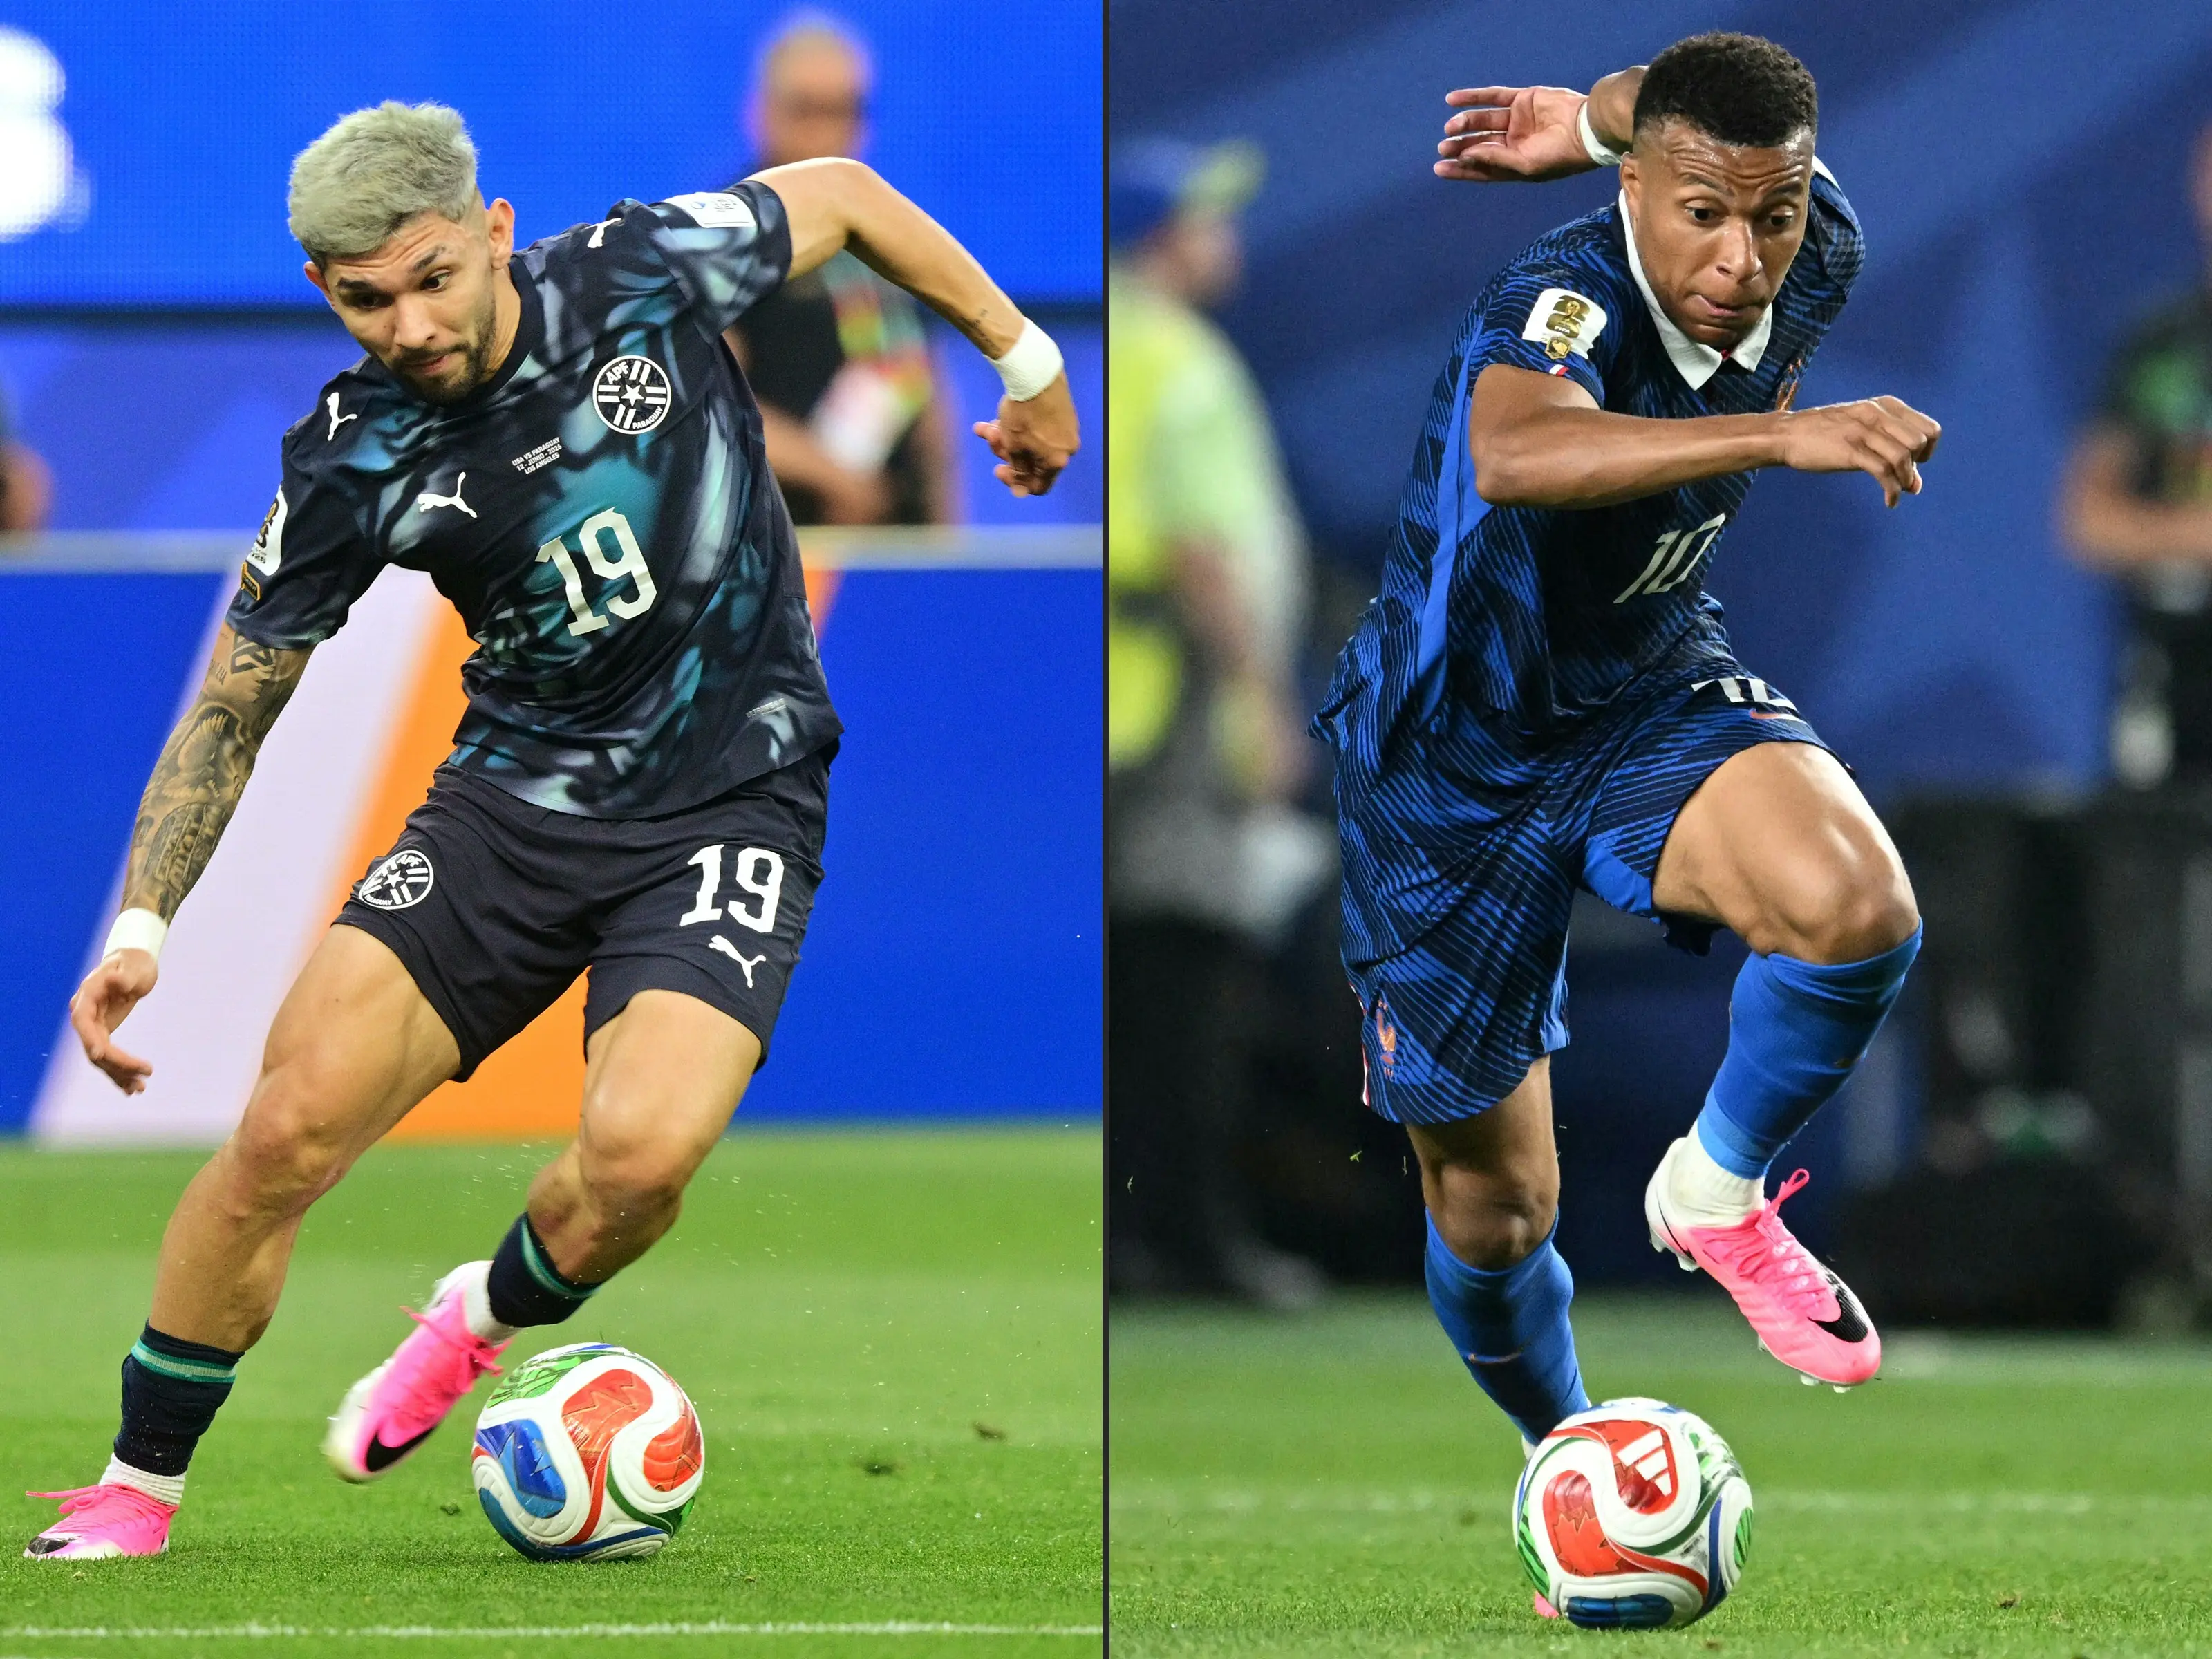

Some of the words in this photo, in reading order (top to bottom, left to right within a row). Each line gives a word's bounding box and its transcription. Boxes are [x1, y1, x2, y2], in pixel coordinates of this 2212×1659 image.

[606, 361, 629, 385] APF
[632, 406, 664, 429] PARAGUAY
[512, 456, 525, 466] USA
[532, 436, 560, 456] PARAGUAY
[524, 465, 536, 474] LOS
[536, 452, 560, 469] ANGELES
[528, 453, 545, 466] JUNIO
[547, 444, 562, 455] 2026
[1613, 513, 1726, 603] 10
[534, 507, 657, 636] 19
[396, 854, 422, 868] APF
[679, 844, 785, 933] 19
